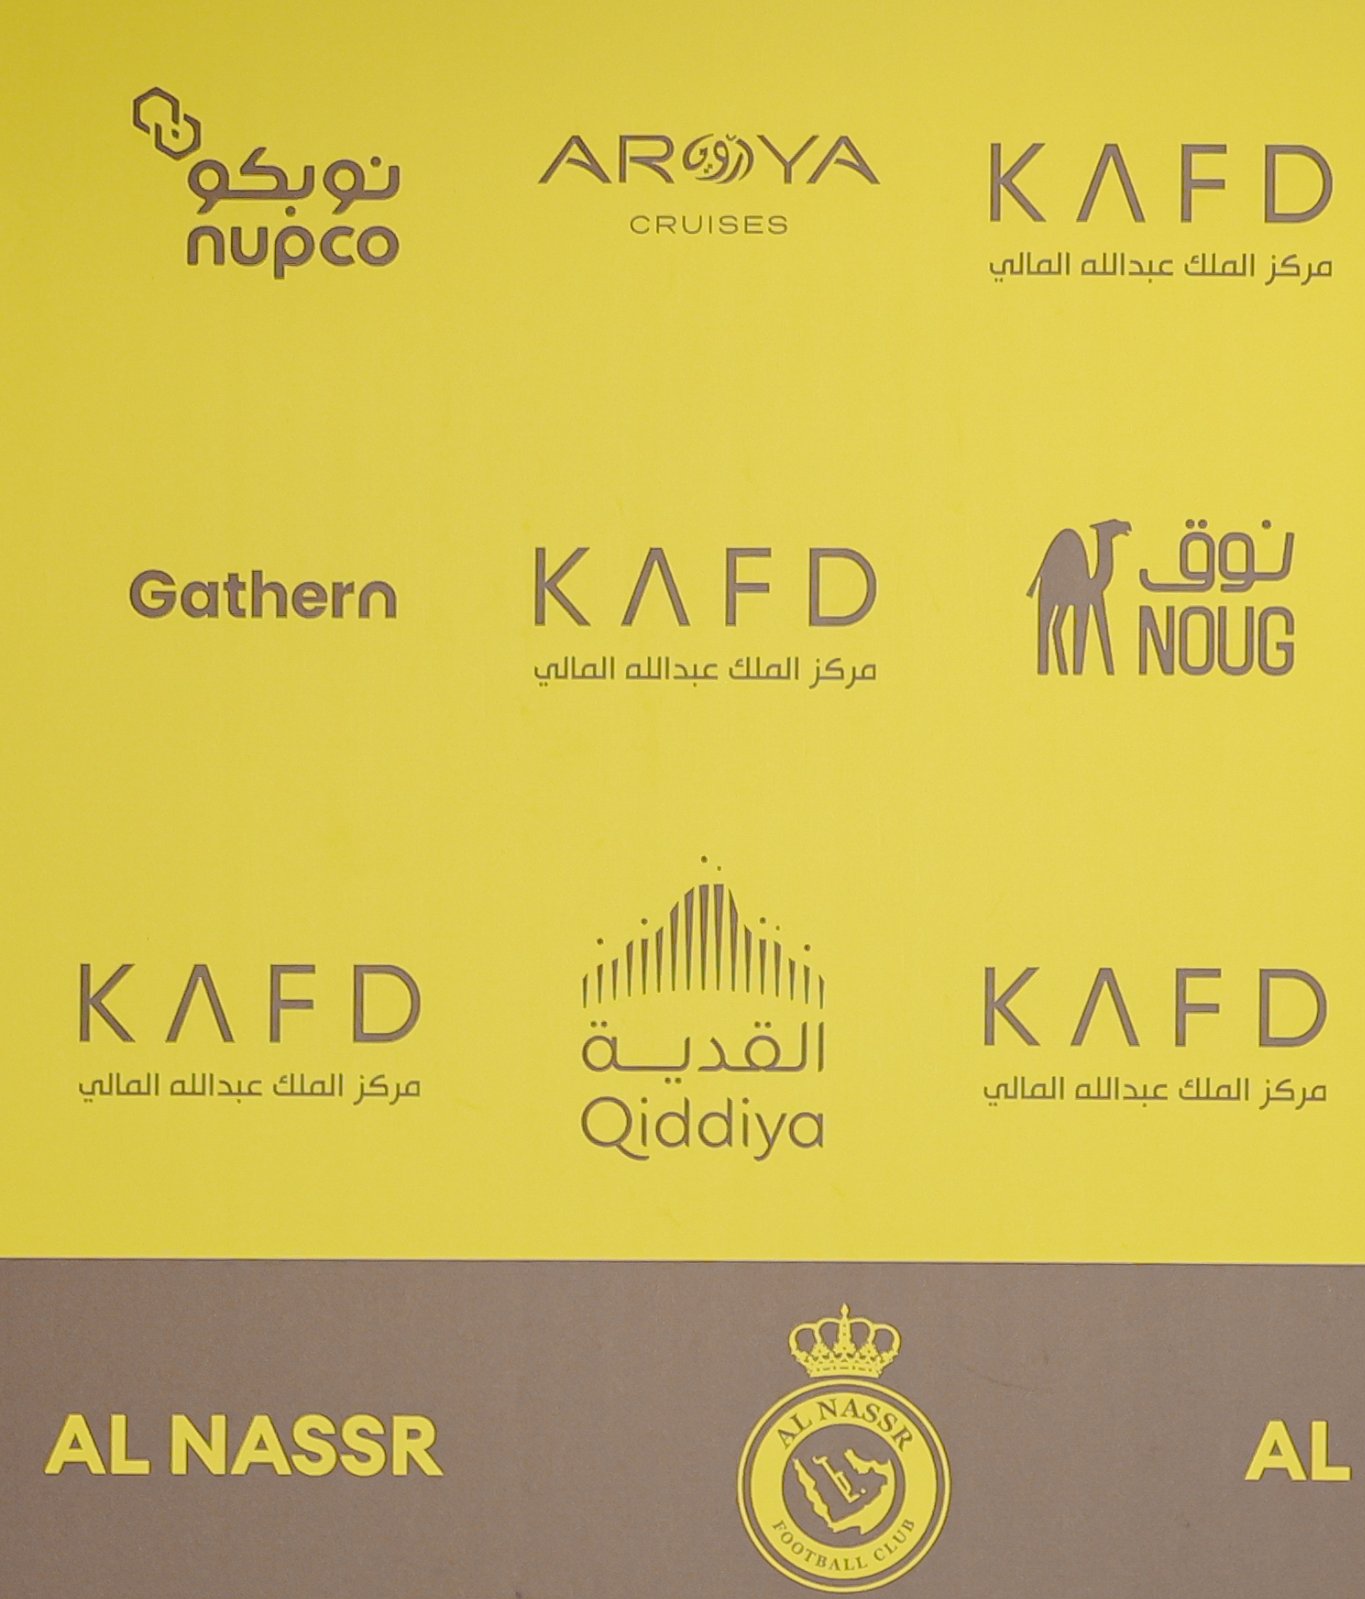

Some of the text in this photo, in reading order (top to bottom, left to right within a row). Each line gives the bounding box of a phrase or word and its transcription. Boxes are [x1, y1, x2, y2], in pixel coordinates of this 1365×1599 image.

[186, 147, 401, 218] نوبكو
[989, 142, 1334, 224] KAFD
[186, 224, 400, 281] nupco
[629, 214, 788, 235] CRUISES
[989, 251, 1333, 286] مركز الملك عبدالله المالي
[534, 546, 877, 627] KAFD
[1138, 518, 1295, 594] نوق
[128, 568, 397, 619] Gathern
[1138, 604, 1295, 677] NOUG
[533, 655, 877, 690] مركز الملك عبدالله المالي
[79, 962, 421, 1044] KAFD
[983, 966, 1328, 1048] KAFD
[78, 1072, 421, 1106] مركز الملك عبدالله المالي
[983, 1075, 1327, 1111] مركز الملك عبدالله المالي
[580, 1095, 824, 1162] Qiddiya
[44, 1414, 444, 1477] AL NASSR
[776, 1398, 914, 1452] AL NASSR
[1244, 1420, 1351, 1481] AL
[772, 1519, 915, 1571] FOOTBALL CLUB
